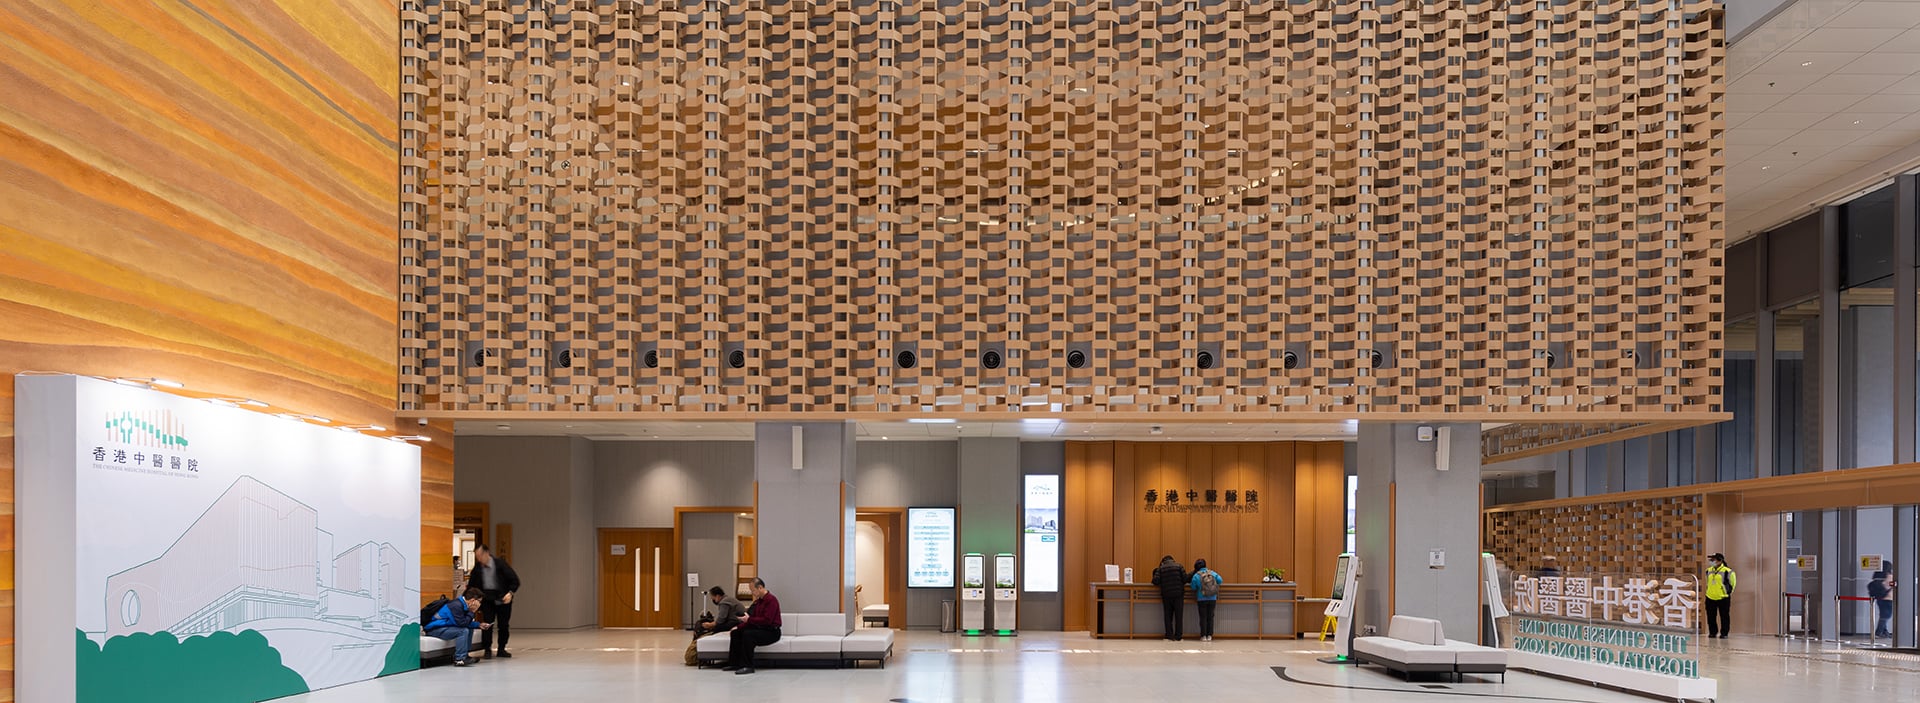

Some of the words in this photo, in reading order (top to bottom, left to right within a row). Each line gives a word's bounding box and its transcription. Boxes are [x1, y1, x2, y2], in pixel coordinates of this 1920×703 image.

[92, 446, 199, 472] 香港中醫醫院
[1145, 489, 1258, 502] 香港中醫醫院
